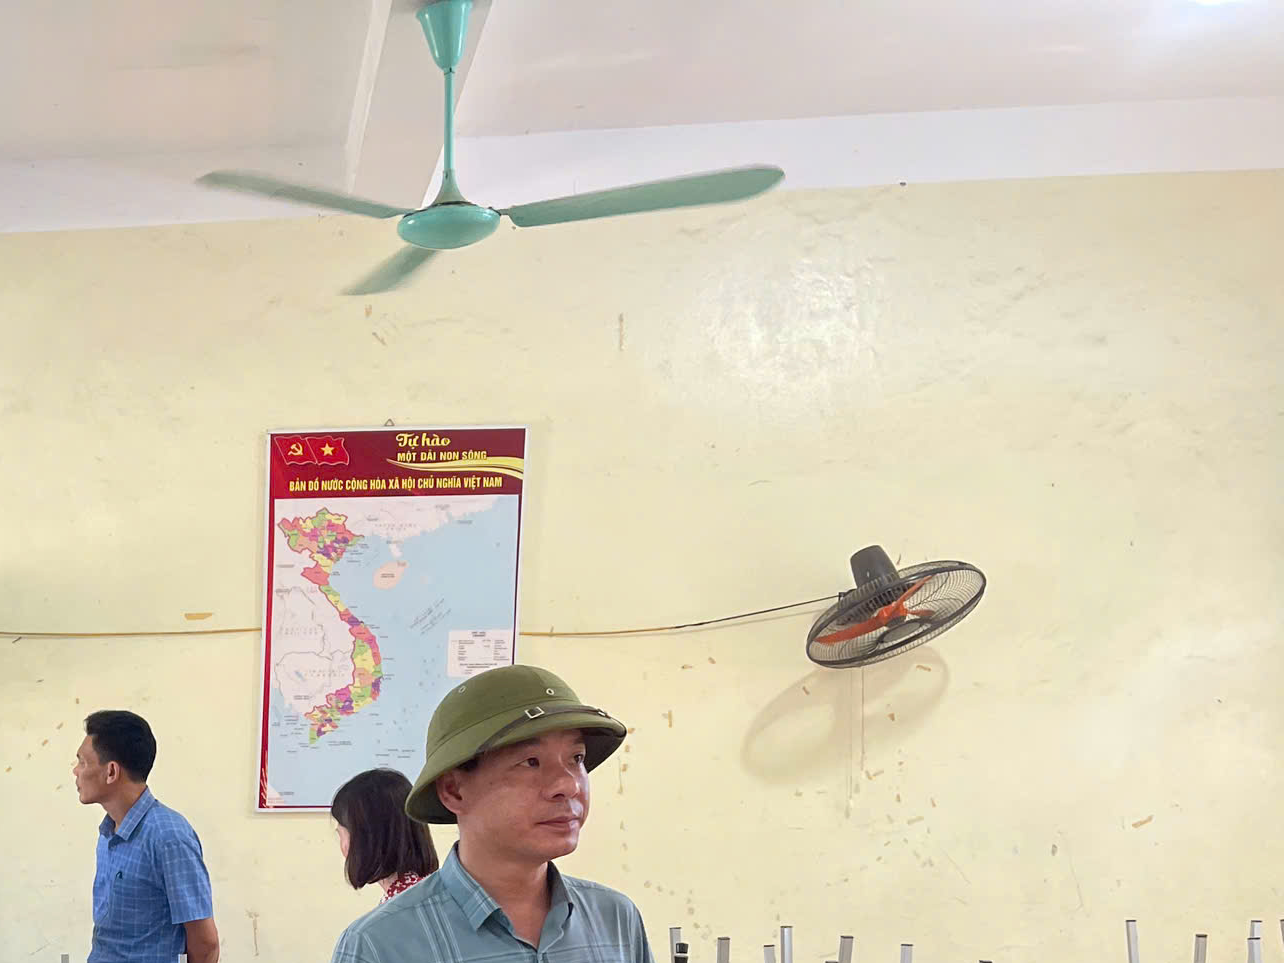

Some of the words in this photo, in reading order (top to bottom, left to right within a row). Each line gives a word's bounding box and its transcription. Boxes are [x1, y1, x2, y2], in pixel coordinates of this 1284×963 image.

[421, 432, 451, 447] hào
[397, 450, 417, 463] MỘT
[439, 451, 459, 461] NON
[461, 449, 487, 461] SÔNG
[289, 477, 306, 492] BẢN
[345, 477, 368, 492] CỘNG
[401, 476, 416, 491] HỘI
[417, 475, 434, 489] CHỦ
[436, 475, 462, 489] NGHĨA
[463, 475, 481, 490] VIỆT
[483, 476, 503, 488] NAM
